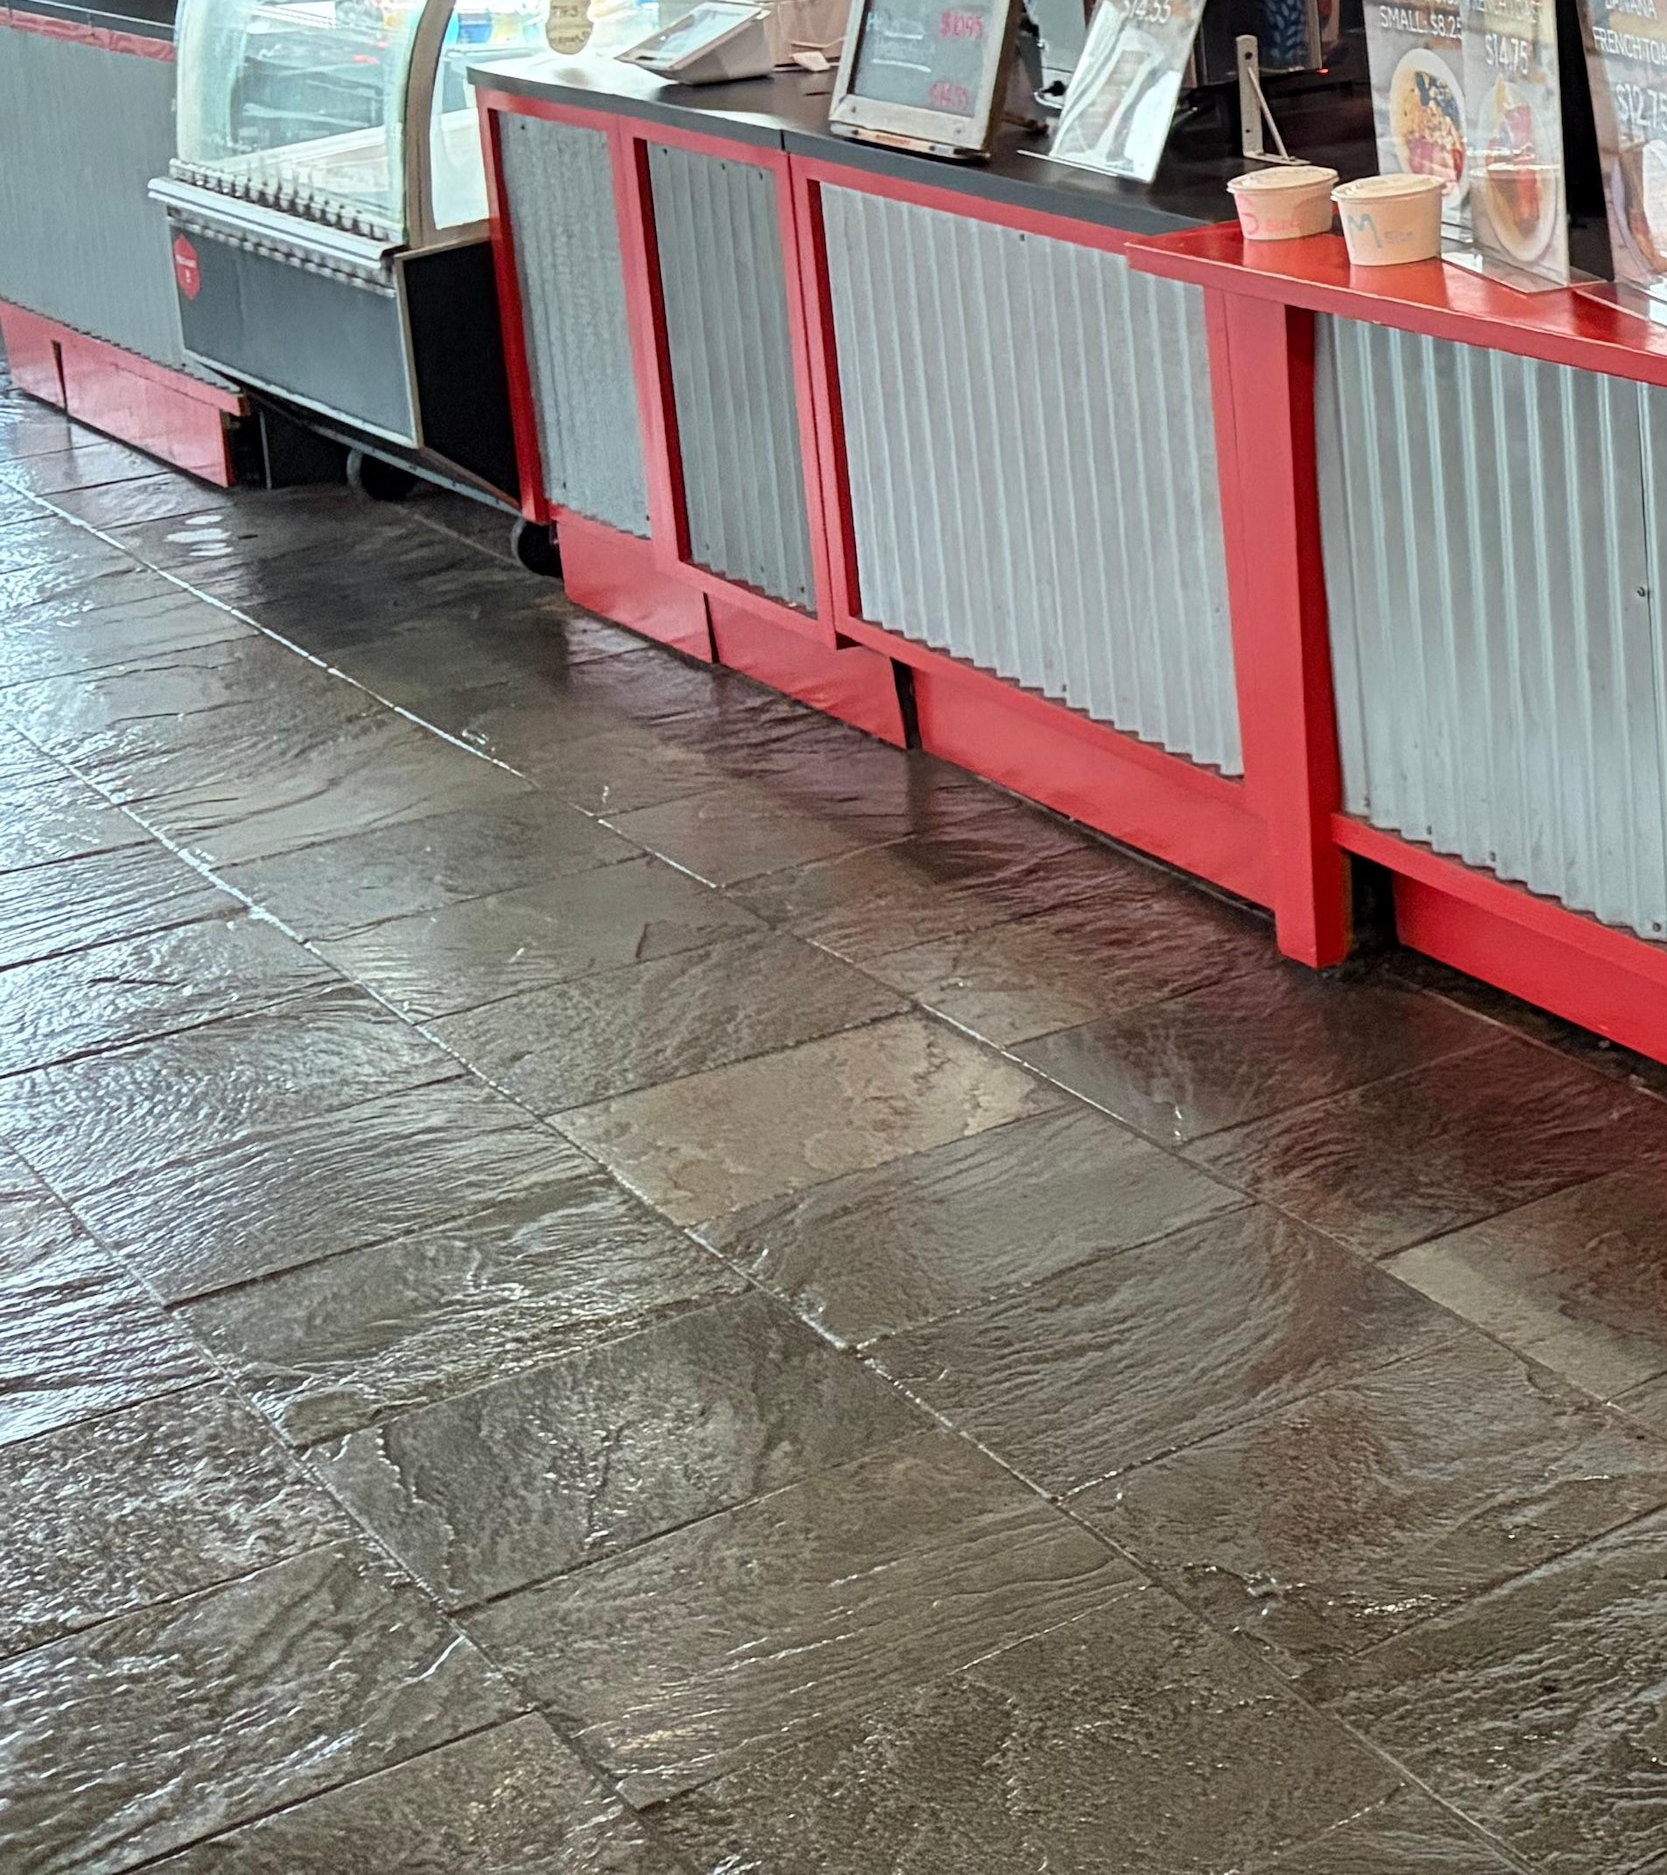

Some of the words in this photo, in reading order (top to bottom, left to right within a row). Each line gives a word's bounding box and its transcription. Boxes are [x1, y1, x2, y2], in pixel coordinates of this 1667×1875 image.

[1380, 5, 1428, 34] SMALL:
[1431, 12, 1463, 41] $8.25
[1485, 33, 1529, 75] $14.75
[1592, 26, 1644, 61] FRENCH
